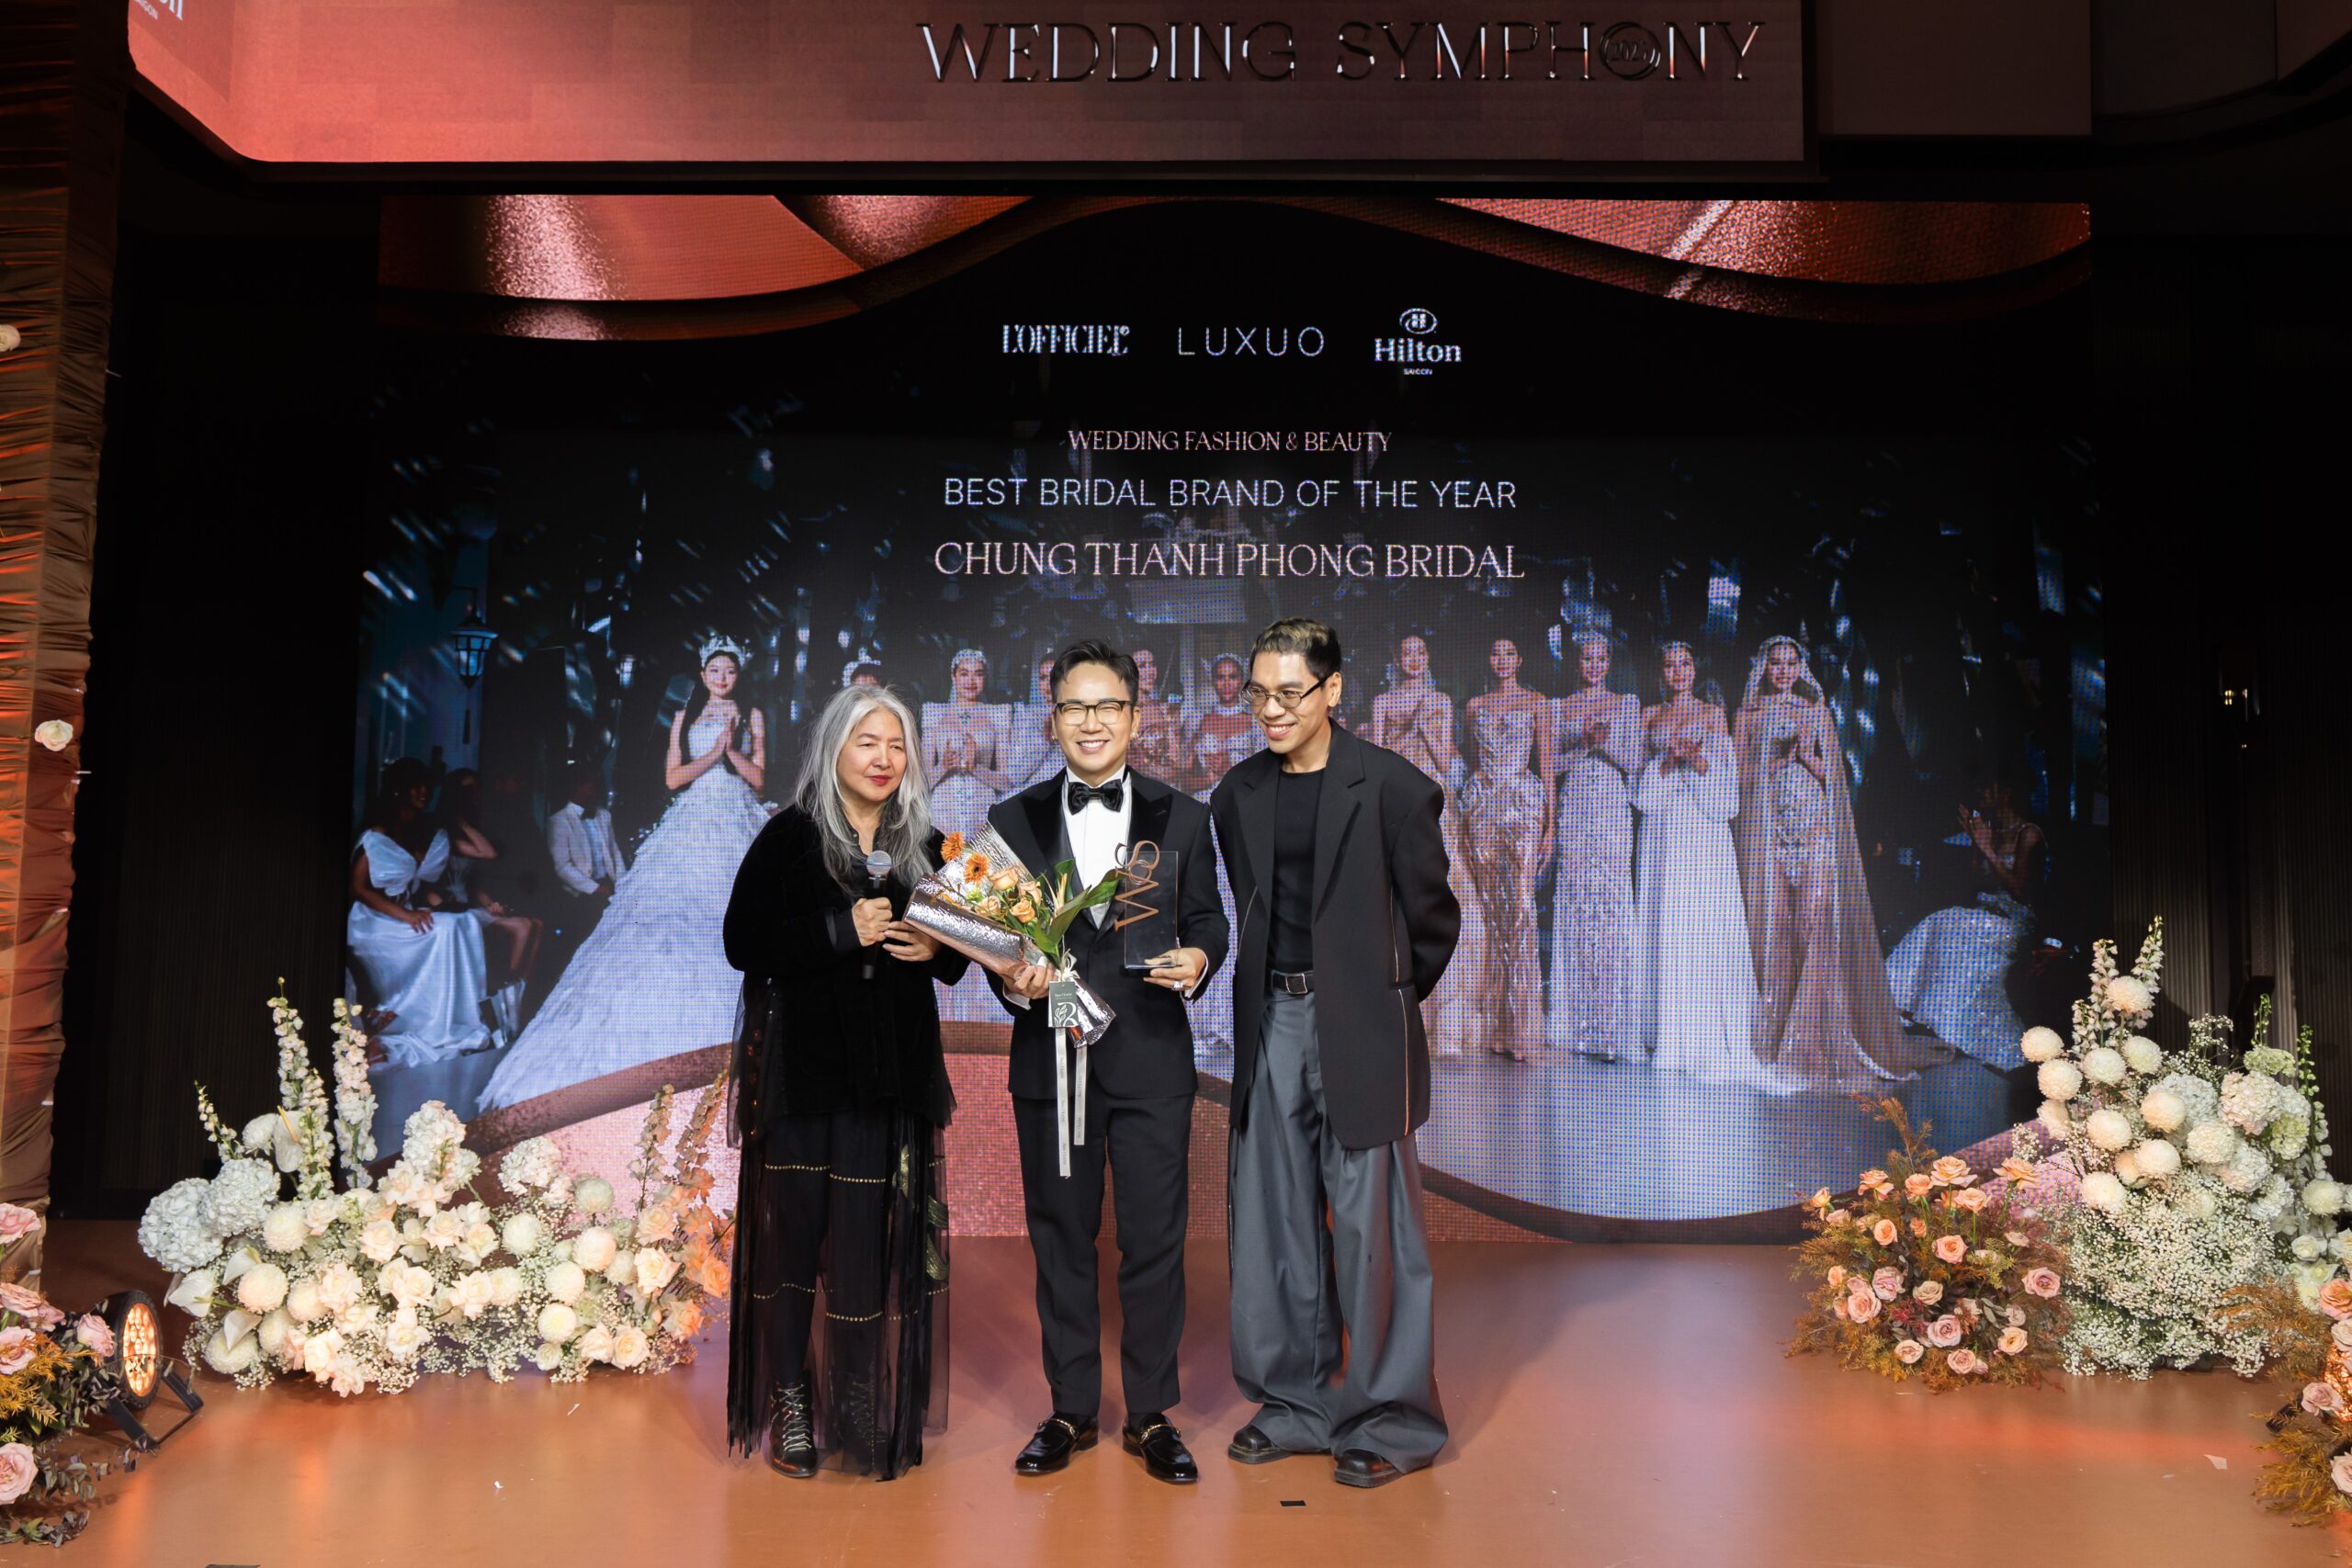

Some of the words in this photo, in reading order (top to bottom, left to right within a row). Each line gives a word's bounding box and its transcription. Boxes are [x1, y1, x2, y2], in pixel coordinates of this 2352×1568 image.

[916, 22, 1296, 82] WEDDING
[1336, 21, 1766, 81] SYMPHONY
[1178, 326, 1325, 357] LUXUO
[1374, 337, 1462, 362] Hilton
[1068, 430, 1179, 450] WEDDING
[1185, 431, 1280, 451] FASHION
[1286, 433, 1298, 450] &
[1305, 432, 1392, 452] BEAUTY
[944, 478, 1027, 505] BEST
[1040, 479, 1156, 505] BRIDAL
[1170, 479, 1284, 506] BRAND
[1296, 479, 1340, 506] OF
[1353, 480, 1418, 507] THE
[1430, 480, 1516, 508] YEAR
[934, 542, 1076, 575] CHUNG
[1084, 543, 1225, 576] THANH
[1236, 543, 1374, 577] PHONG
[1385, 544, 1525, 578] BRIDAL
